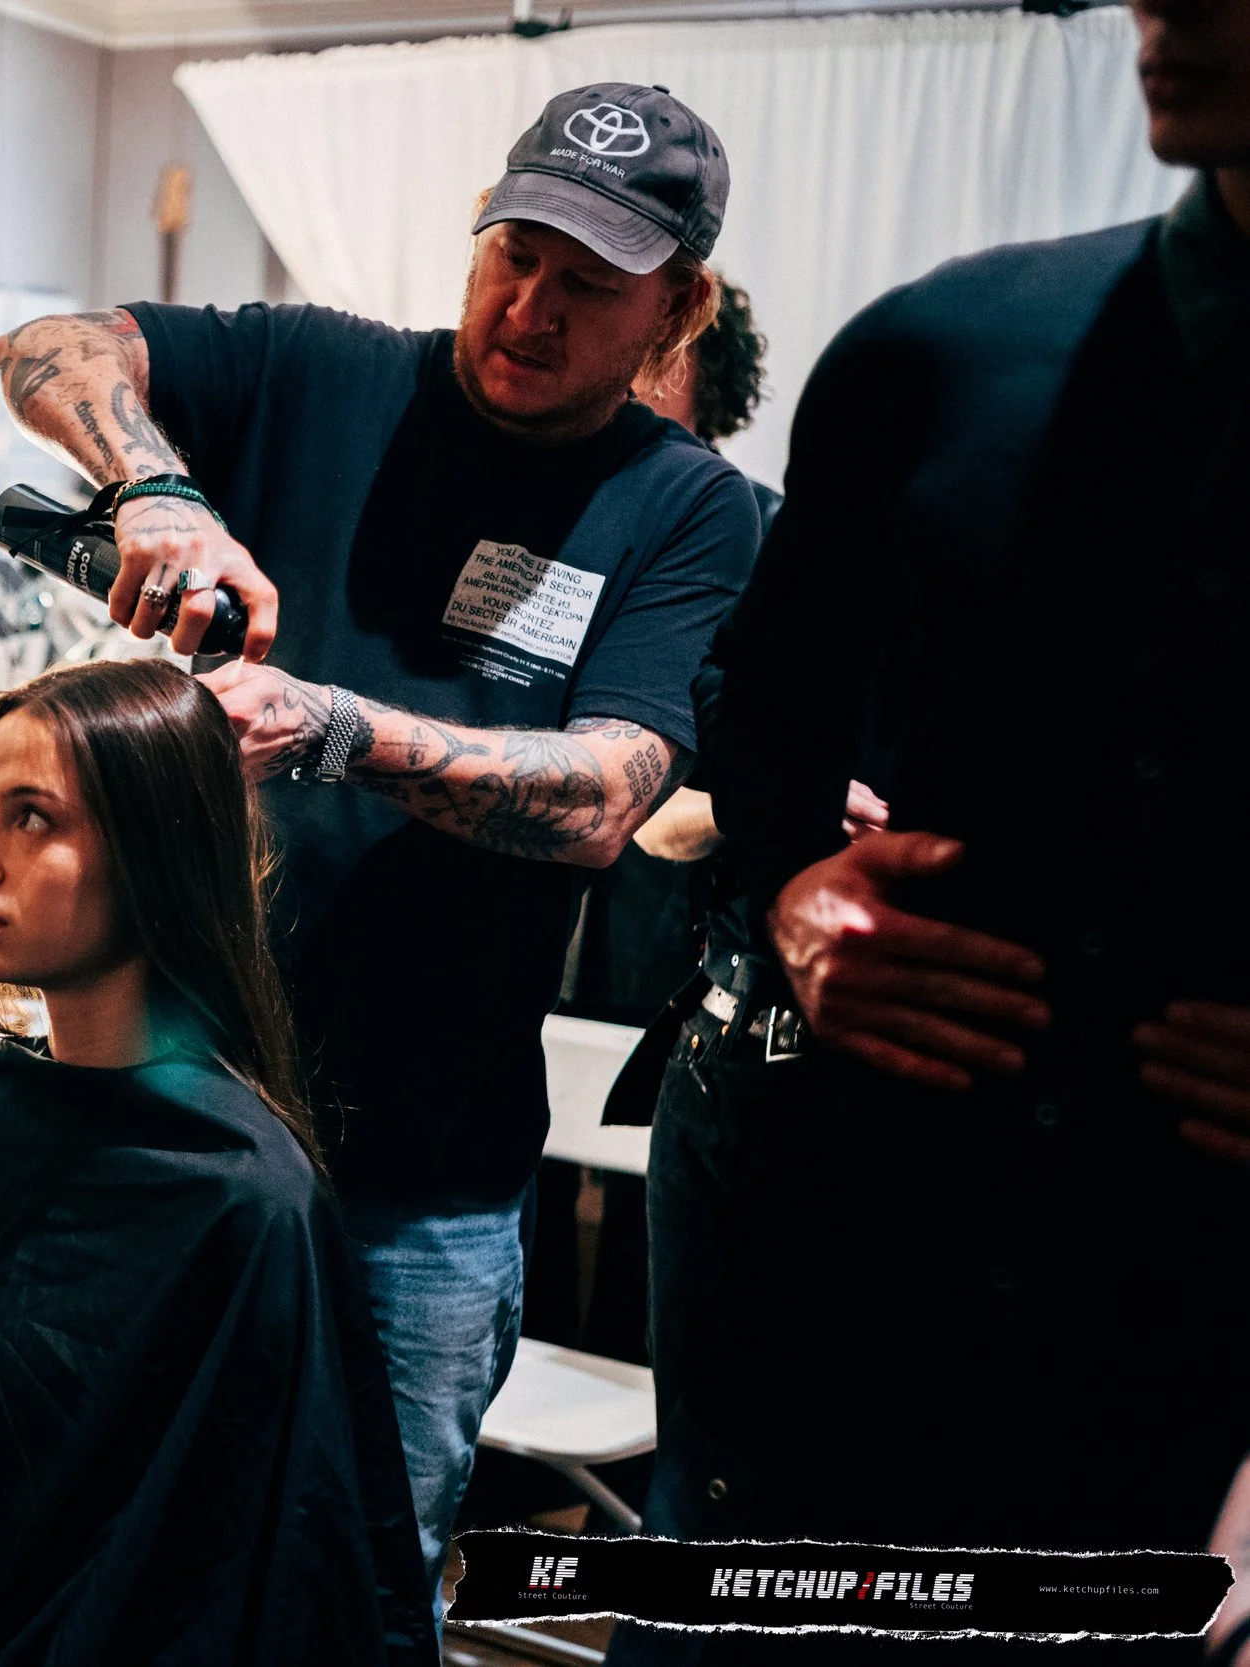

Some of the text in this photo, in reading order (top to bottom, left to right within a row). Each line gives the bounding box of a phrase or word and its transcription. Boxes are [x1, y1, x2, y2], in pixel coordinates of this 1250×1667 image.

[550, 148, 626, 179] MADE FOR WAR
[475, 553, 593, 600] THE AMERICAN SECTOR
[496, 547, 582, 584] YOU ARE LEAVING
[451, 601, 467, 612] DU
[469, 605, 518, 627] SECTEUR
[519, 623, 578, 650] AMERICAIN
[483, 595, 512, 612] VOUS
[513, 605, 555, 630] SORTEZ
[542, 605, 583, 623] СЕКТОРА
[633, 750, 653, 797] SPIRO
[645, 743, 664, 782] DUM
